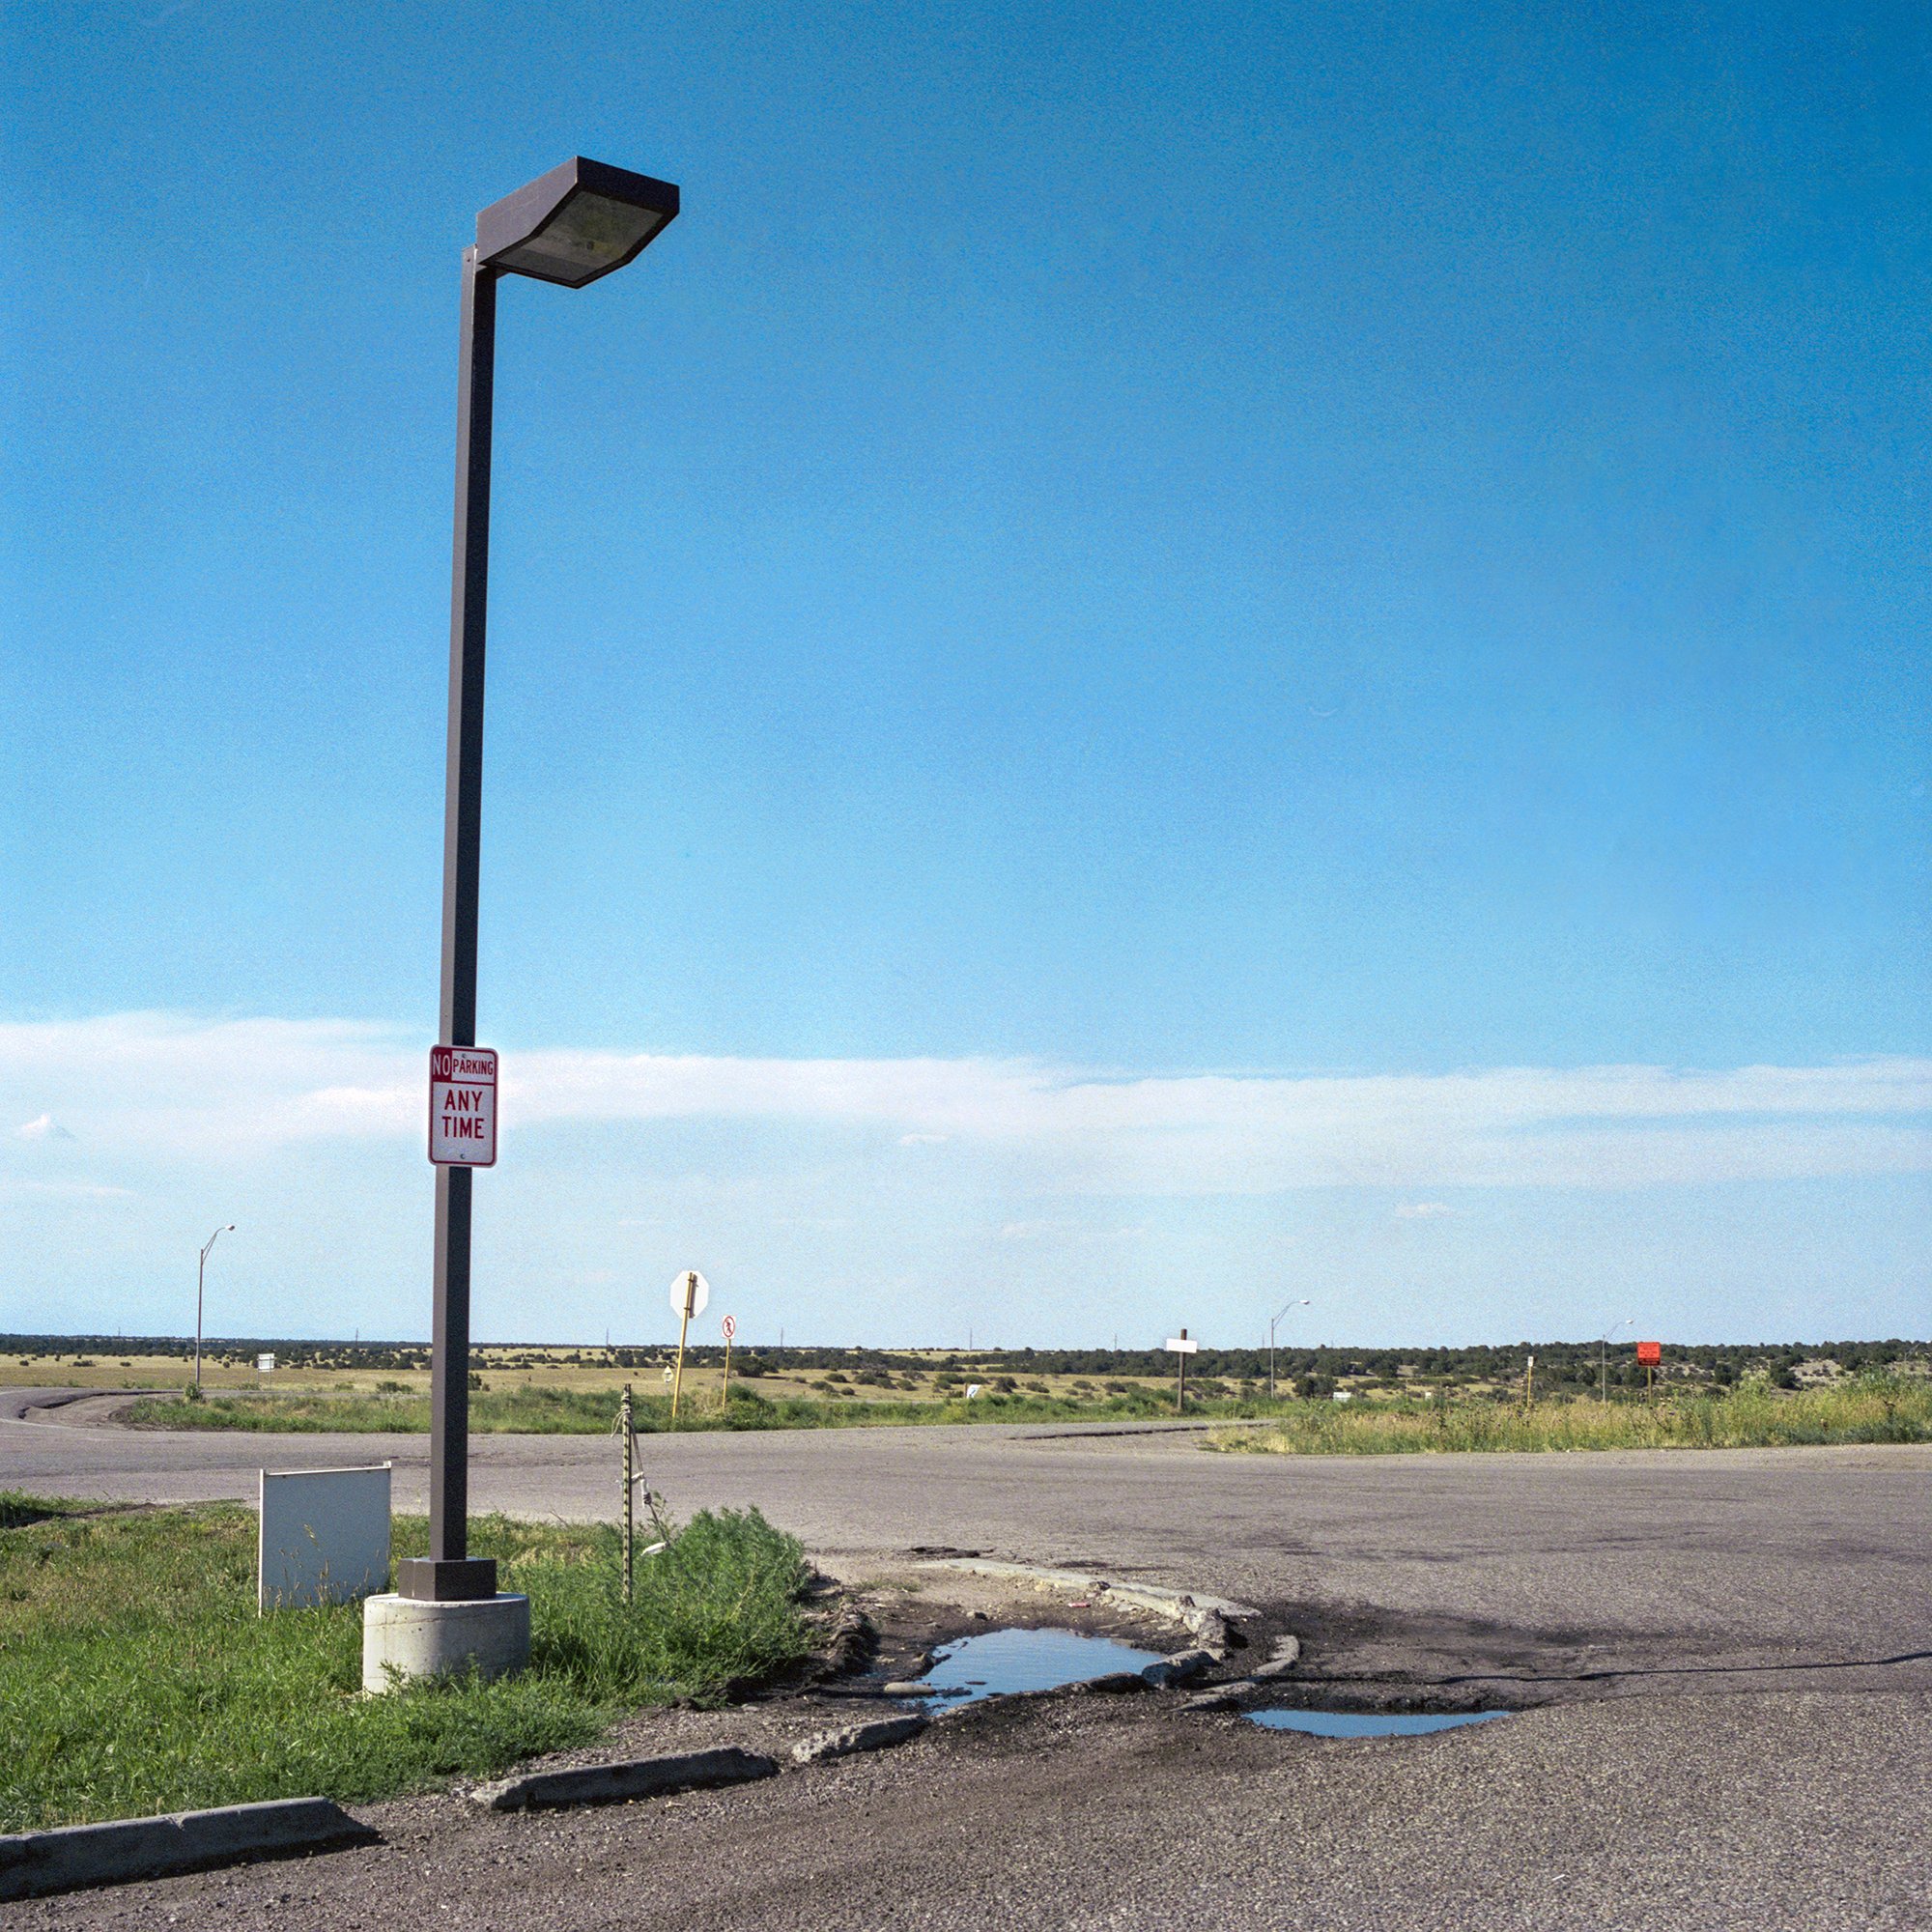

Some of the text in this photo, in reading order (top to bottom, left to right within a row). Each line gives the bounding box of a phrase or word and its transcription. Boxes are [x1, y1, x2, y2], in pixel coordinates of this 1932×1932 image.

[433, 1054, 494, 1076] NO PARKING
[444, 1089, 483, 1112] ANY
[441, 1116, 485, 1139] TIME
